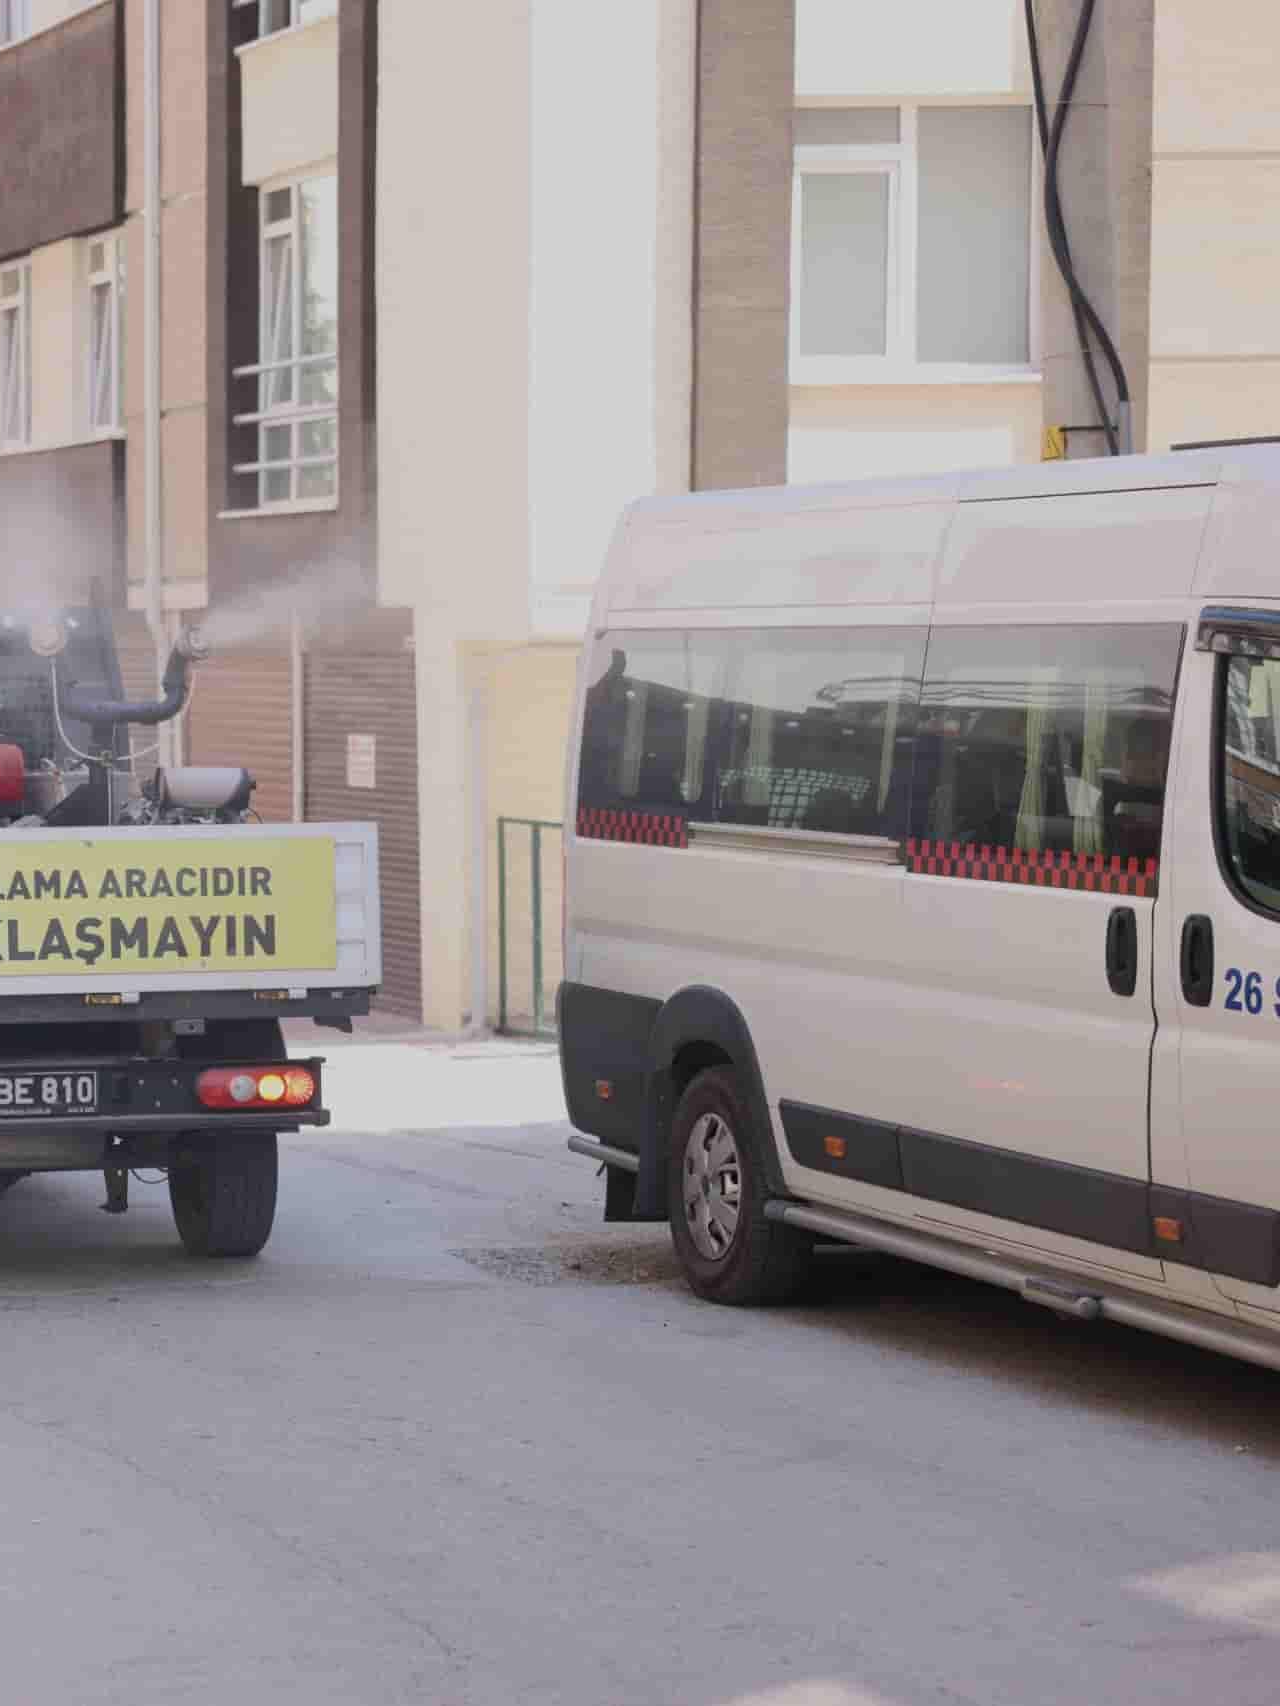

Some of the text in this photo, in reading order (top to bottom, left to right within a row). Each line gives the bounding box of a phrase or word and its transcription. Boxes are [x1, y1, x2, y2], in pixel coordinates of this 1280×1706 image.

[98, 866, 273, 900] ARACIDIR
[1223, 967, 1264, 1016] 26
[41, 1075, 94, 1104] 810
